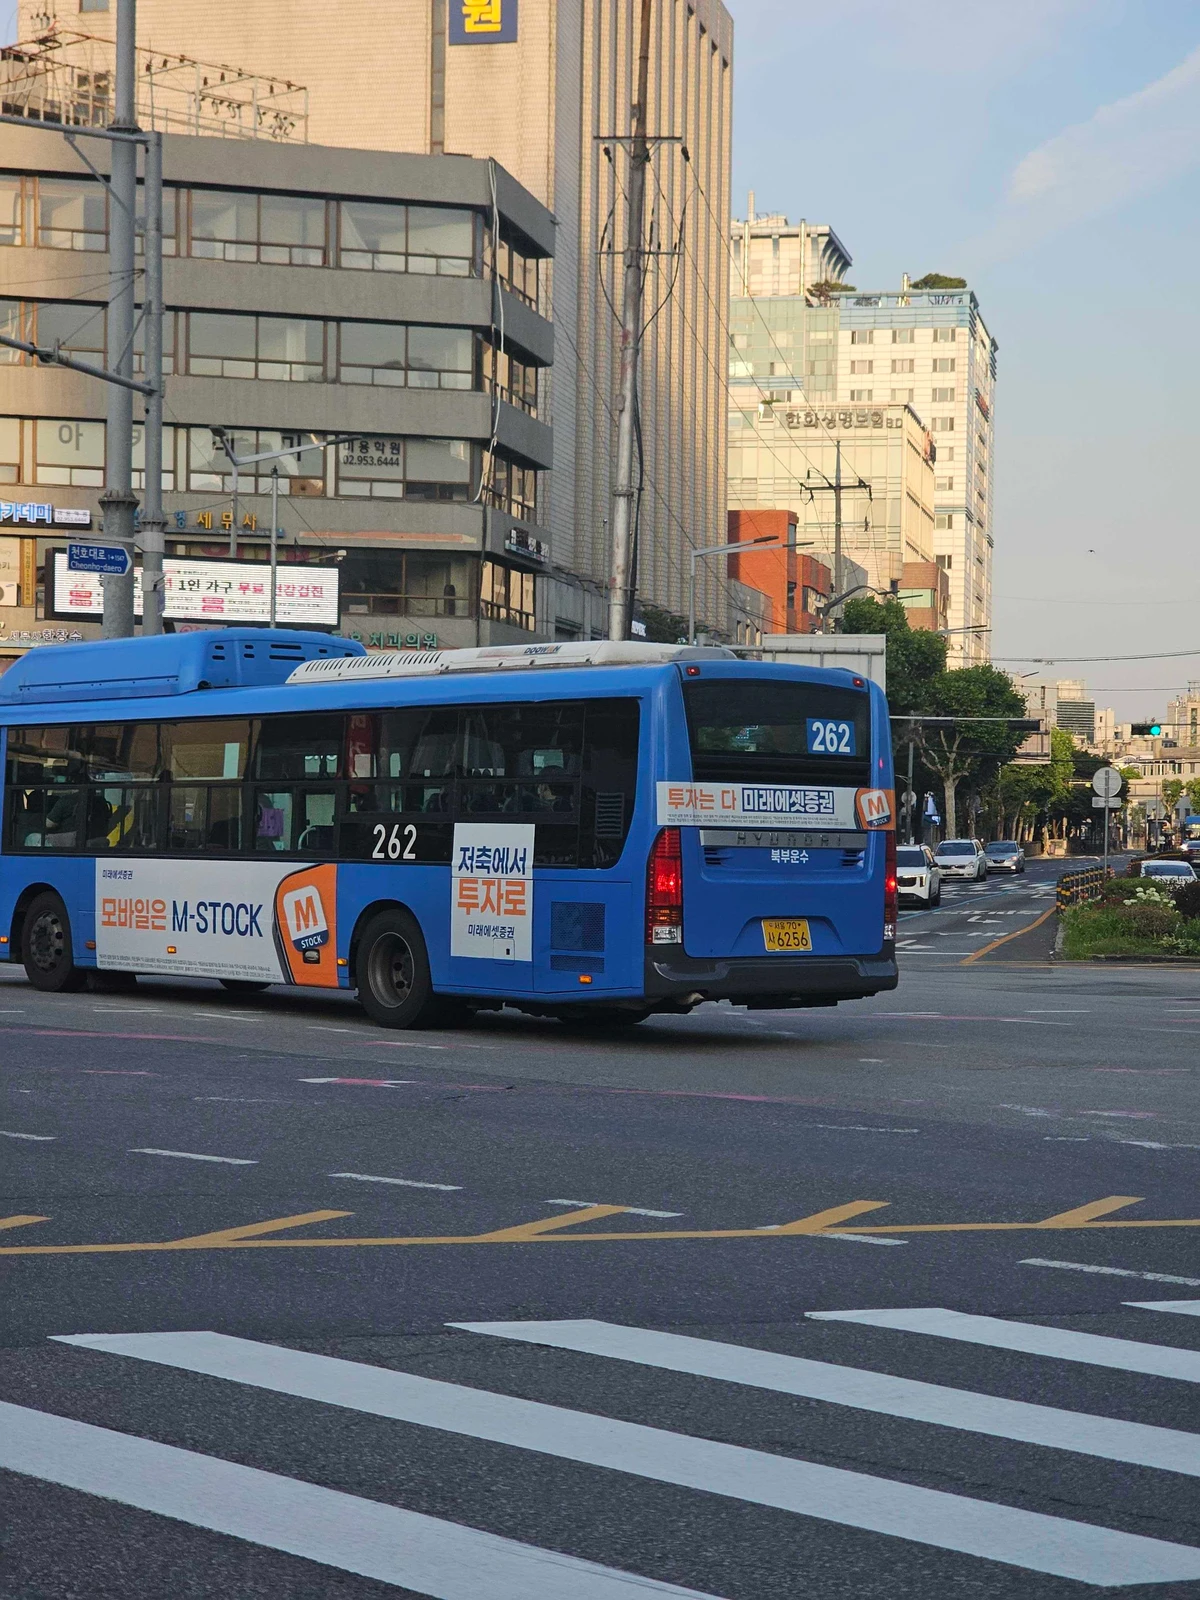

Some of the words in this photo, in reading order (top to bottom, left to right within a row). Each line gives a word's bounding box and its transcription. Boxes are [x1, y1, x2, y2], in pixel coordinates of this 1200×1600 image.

[462, 0, 502, 33] 원
[343, 455, 400, 467] 02.953.6444
[71, 546, 107, 560] 천호대로
[70, 560, 122, 573] Cheonho-daero
[178, 579, 200, 592] 1인
[206, 580, 233, 594] 가구
[811, 721, 851, 753] 262
[667, 788, 715, 810] 투자는
[721, 789, 737, 811] 다
[743, 789, 834, 813] 미래에셋증권
[867, 795, 885, 817] M
[371, 823, 418, 860] 262
[457, 845, 528, 876] 저축에서
[771, 848, 809, 864] 북부운수
[102, 869, 134, 880] 미래에셋증권
[457, 878, 527, 916] 투자로
[101, 898, 167, 931] 모바일은
[172, 900, 263, 937] M-STOCK
[294, 895, 320, 932] M
[467, 924, 516, 939] 미래에셋증권
[777, 931, 808, 947] 6256
[300, 934, 323, 949] STOCK
